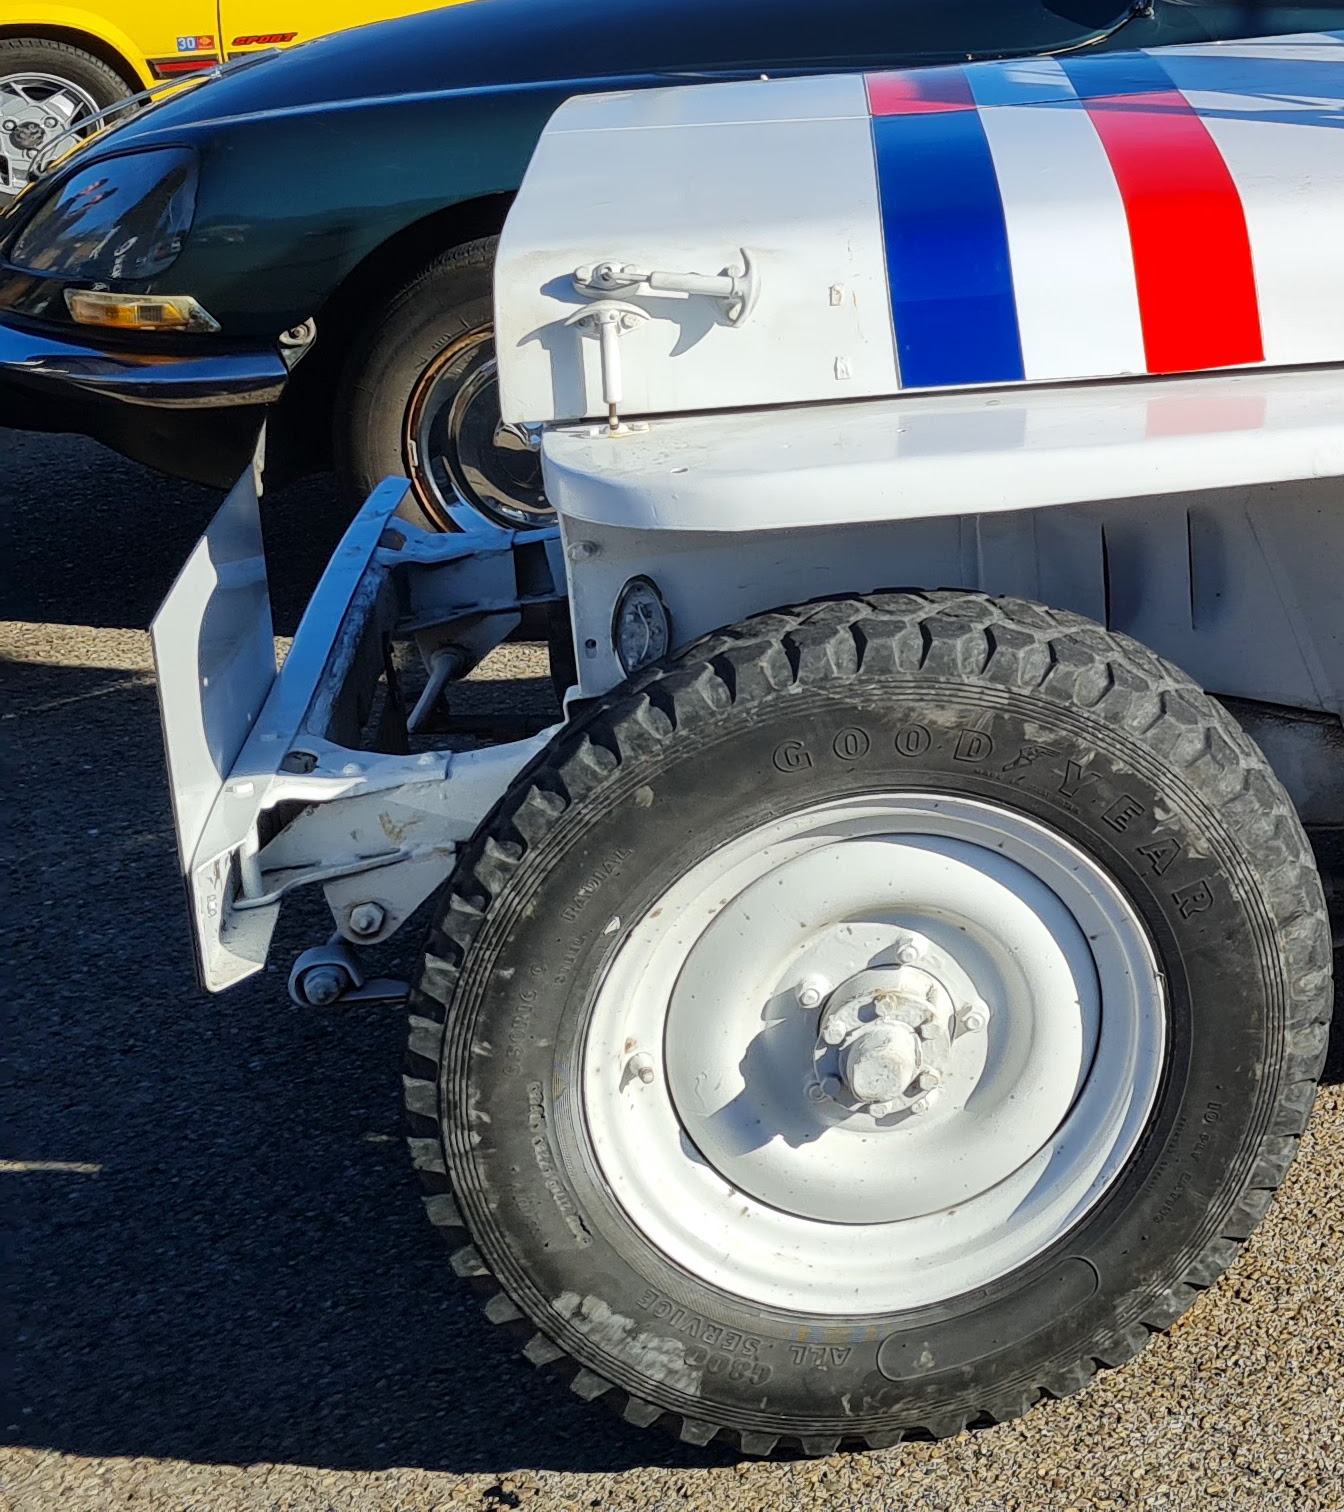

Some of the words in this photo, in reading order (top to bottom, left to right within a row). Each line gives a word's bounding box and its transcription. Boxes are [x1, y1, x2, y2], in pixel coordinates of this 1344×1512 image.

[177, 37, 197, 50] 30
[231, 32, 298, 46] SPORT
[772, 723, 1216, 920] GOODYEAR
[560, 847, 634, 922] RADIAL
[1203, 1101, 1223, 1124] 10
[635, 1288, 762, 1356] SERVICE
[789, 1344, 852, 1367] ALL
